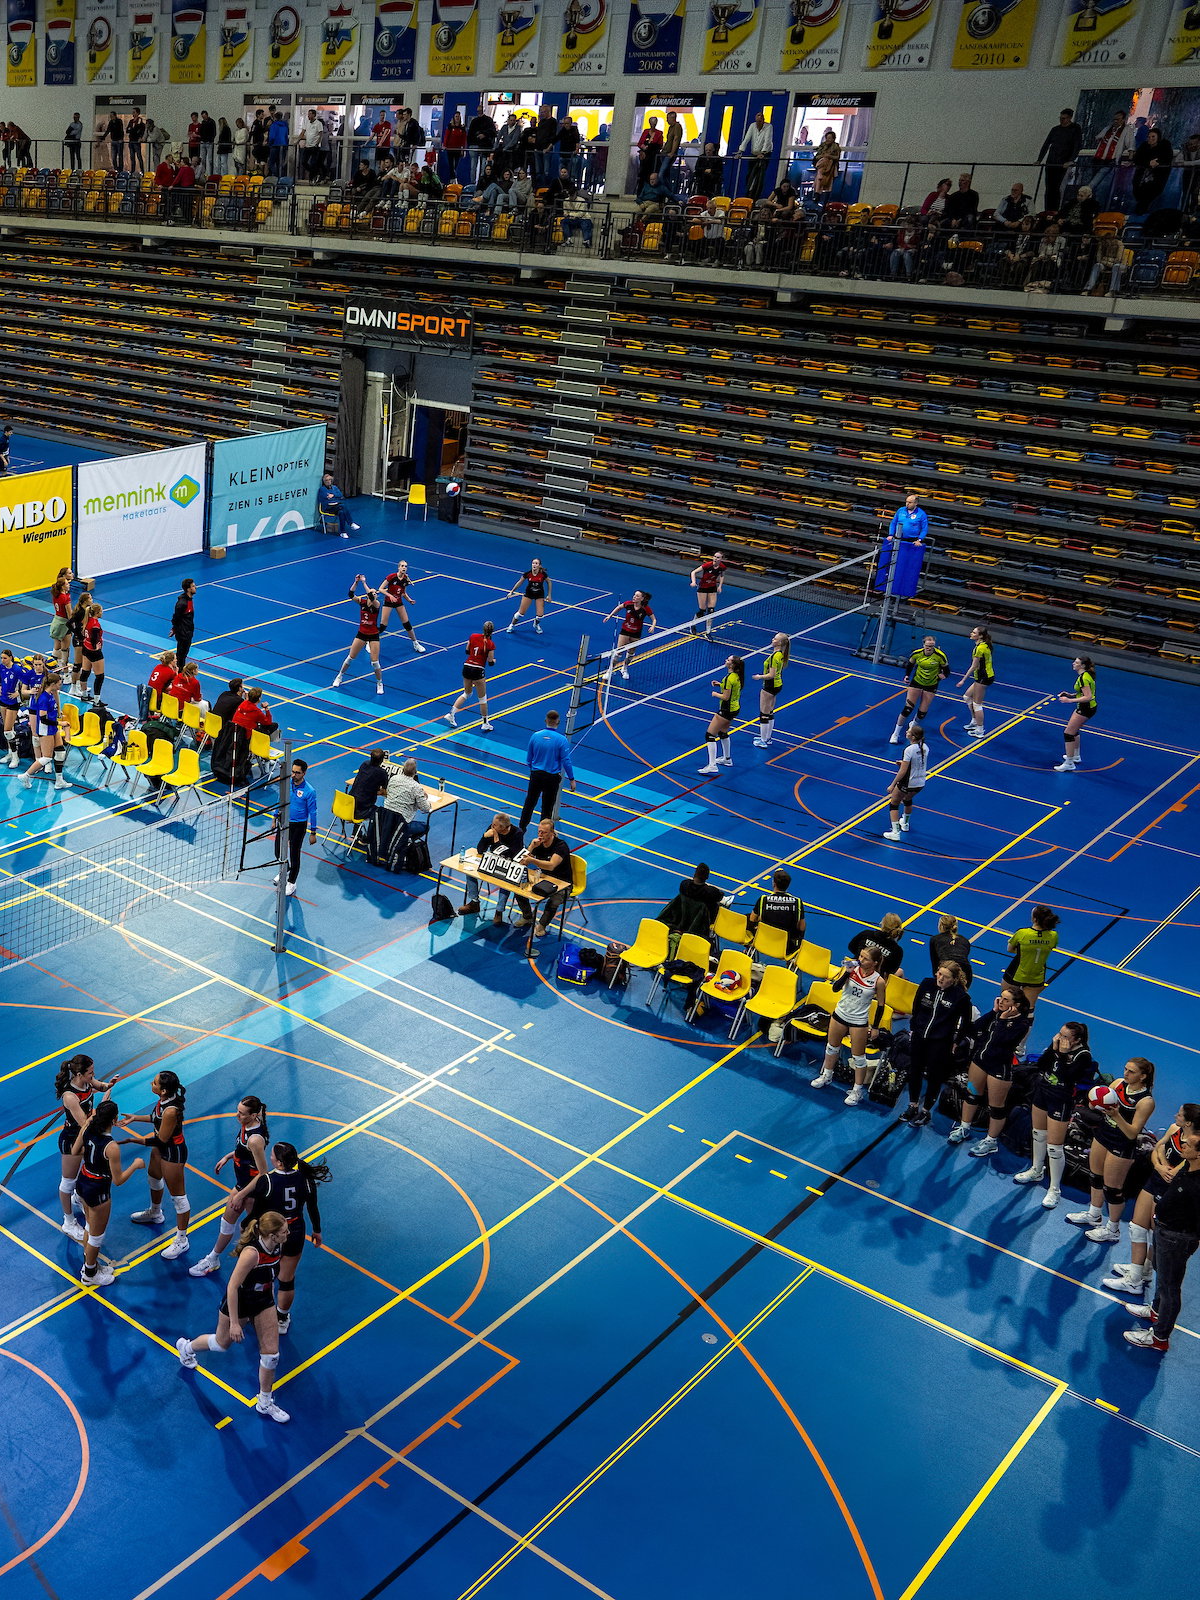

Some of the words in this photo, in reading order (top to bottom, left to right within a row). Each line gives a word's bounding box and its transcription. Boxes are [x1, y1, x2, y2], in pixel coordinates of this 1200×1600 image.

[880, 54, 911, 65] 2010
[972, 53, 1005, 65] 2010
[1074, 49, 1109, 62] 2010
[441, 64, 461, 73] 2007
[504, 60, 525, 70] 2007
[569, 61, 592, 71] 2008
[638, 60, 663, 71] 2008
[714, 59, 739, 70] 2008
[794, 58, 821, 69] 2009
[226, 70, 241, 78] 2001
[275, 69, 292, 78] 2002
[328, 68, 345, 77] 2003
[382, 67, 402, 76] 2003
[346, 306, 470, 337] OMNISPORT
[230, 466, 274, 486] KLEIN
[277, 459, 309, 473] OPTIEK
[83, 482, 167, 515] mennink
[229, 500, 250, 511] ZIEN
[255, 497, 262, 506] IS
[268, 488, 308, 503] BELEVEN
[23, 527, 67, 544] Wiegmans
[473, 646, 480, 656] 1
[151, 671, 160, 682] 3
[482, 857, 495, 870] 10
[509, 866, 521, 879] 19
[1035, 948, 1041, 963] 1
[852, 987, 863, 997] 22
[88, 1140, 96, 1158] 7
[283, 1186, 297, 1211] 5
